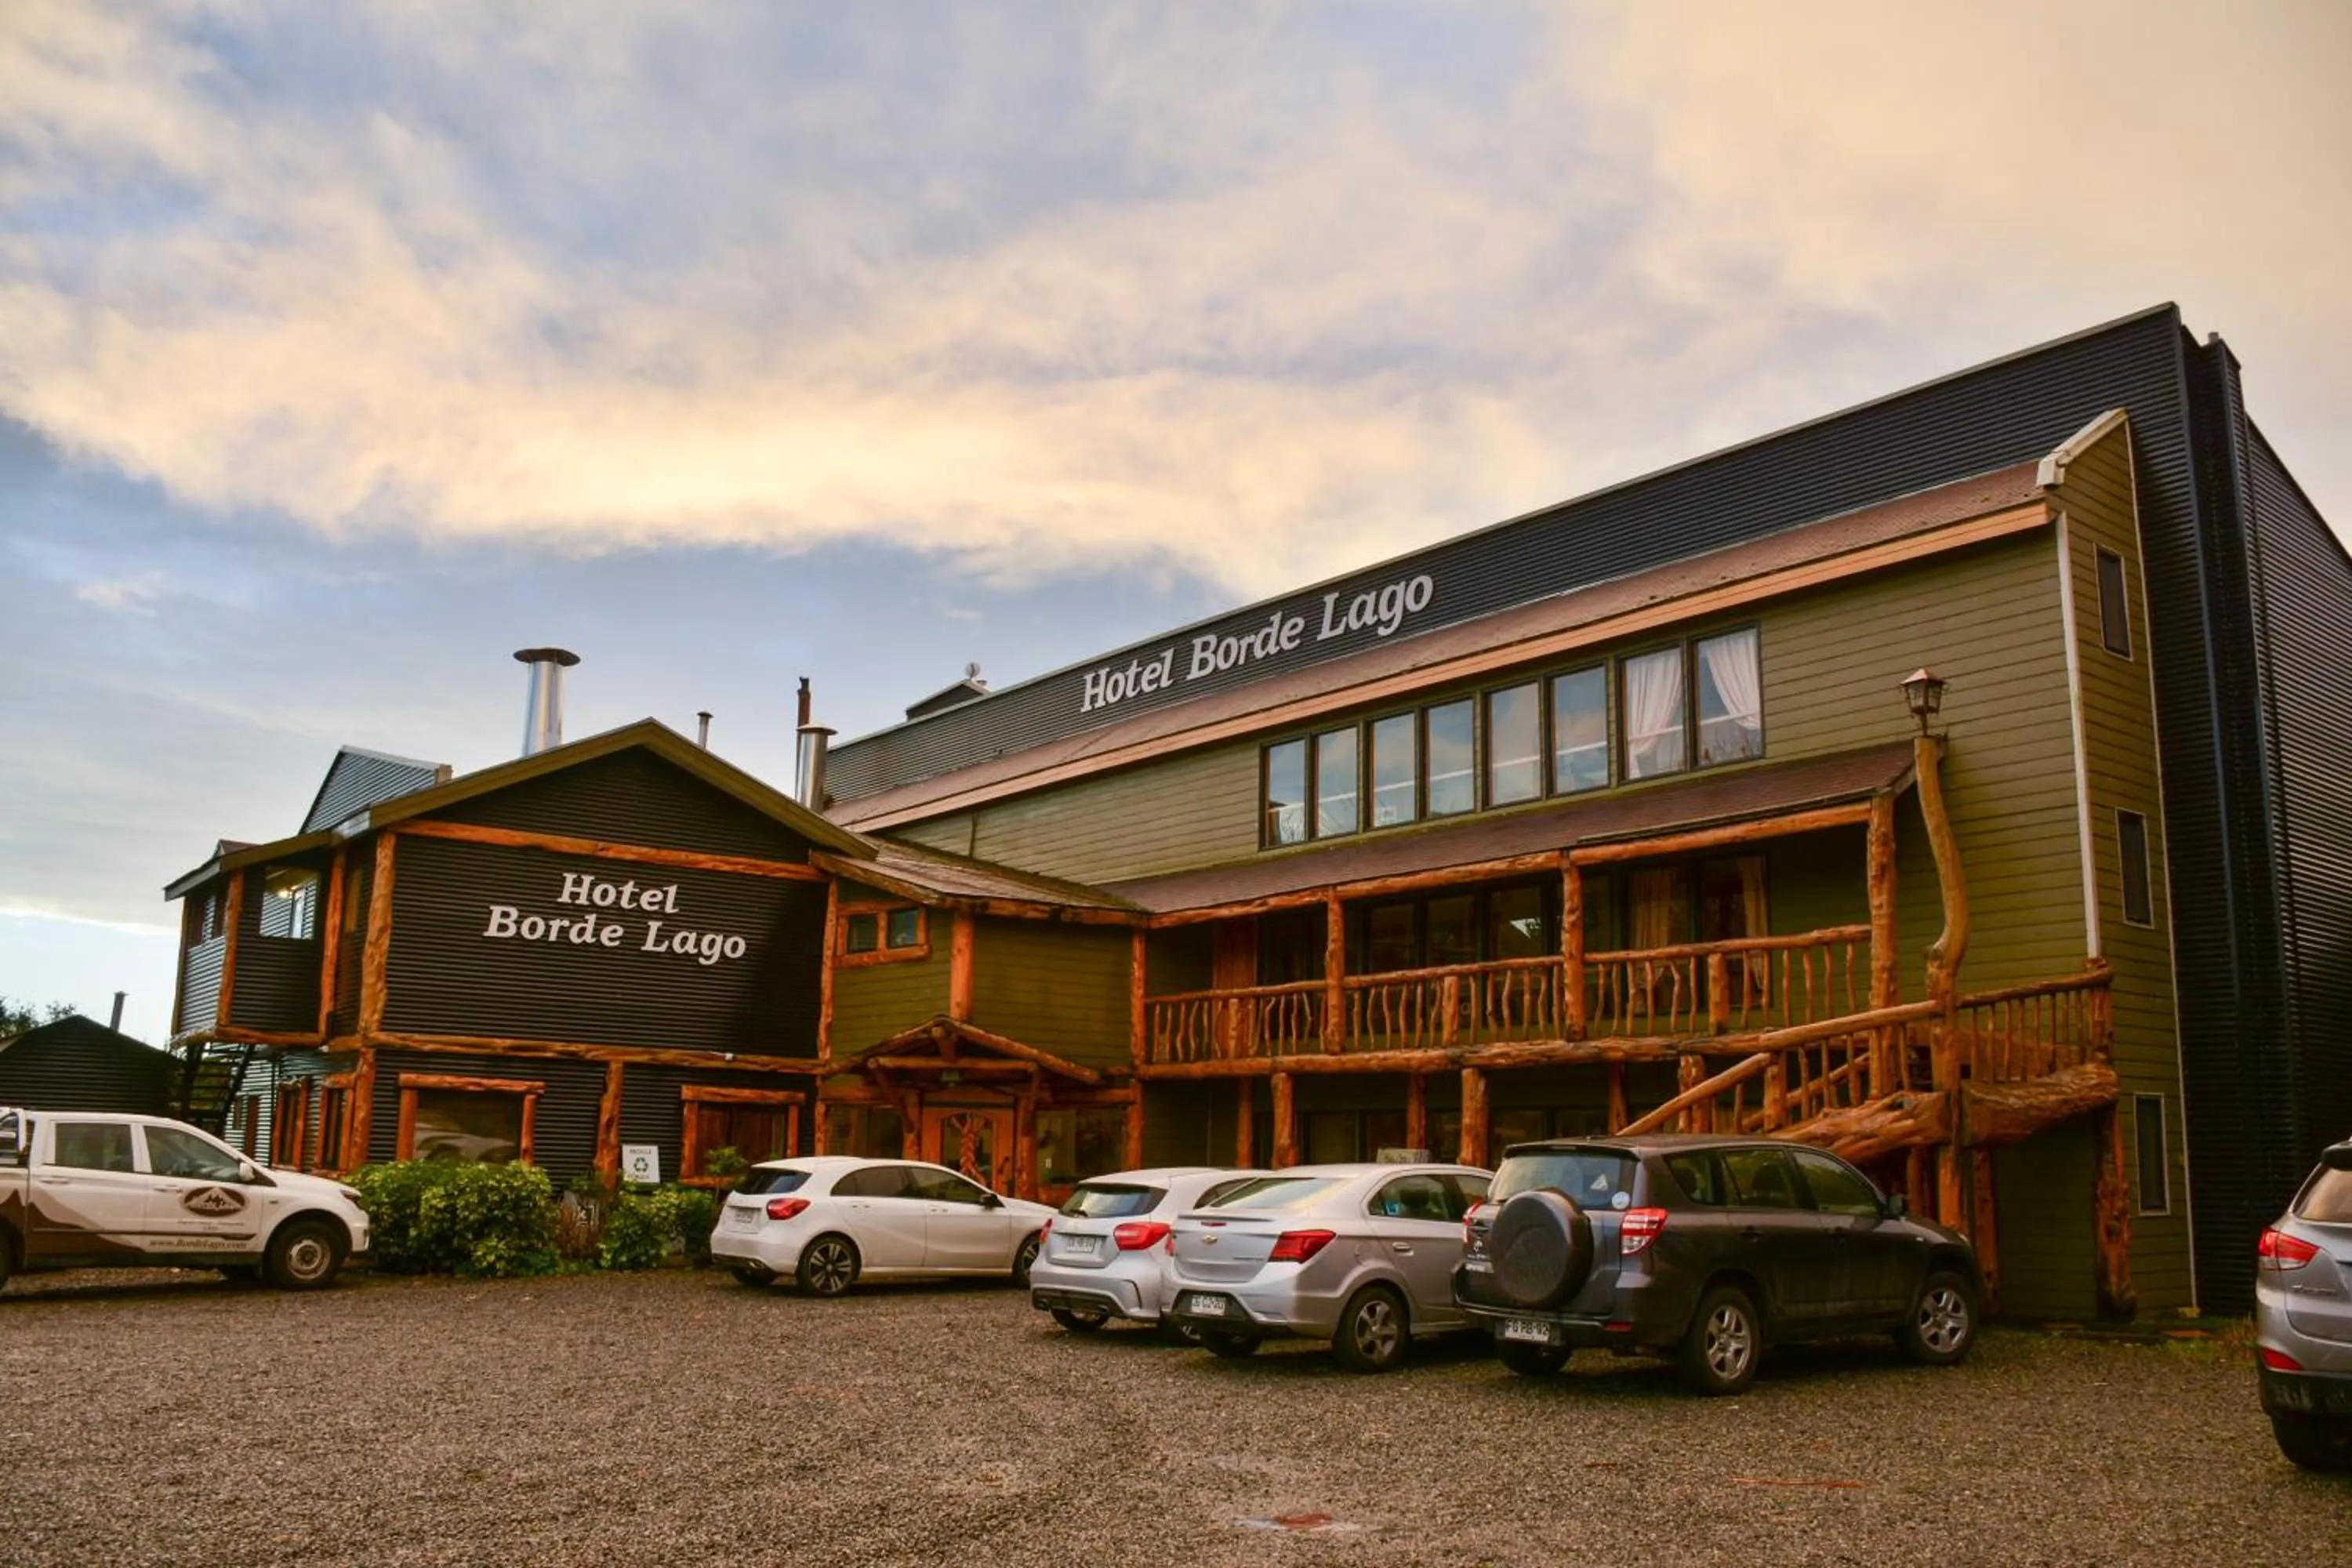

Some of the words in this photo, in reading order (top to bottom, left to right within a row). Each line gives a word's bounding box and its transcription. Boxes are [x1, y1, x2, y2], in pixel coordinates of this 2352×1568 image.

[1080, 648, 1174, 712] Hotel
[1185, 612, 1305, 680] Borde
[1316, 575, 1434, 640] Lago
[557, 873, 679, 913] Hotel
[482, 906, 624, 947] Borde
[641, 920, 746, 966] Lago
